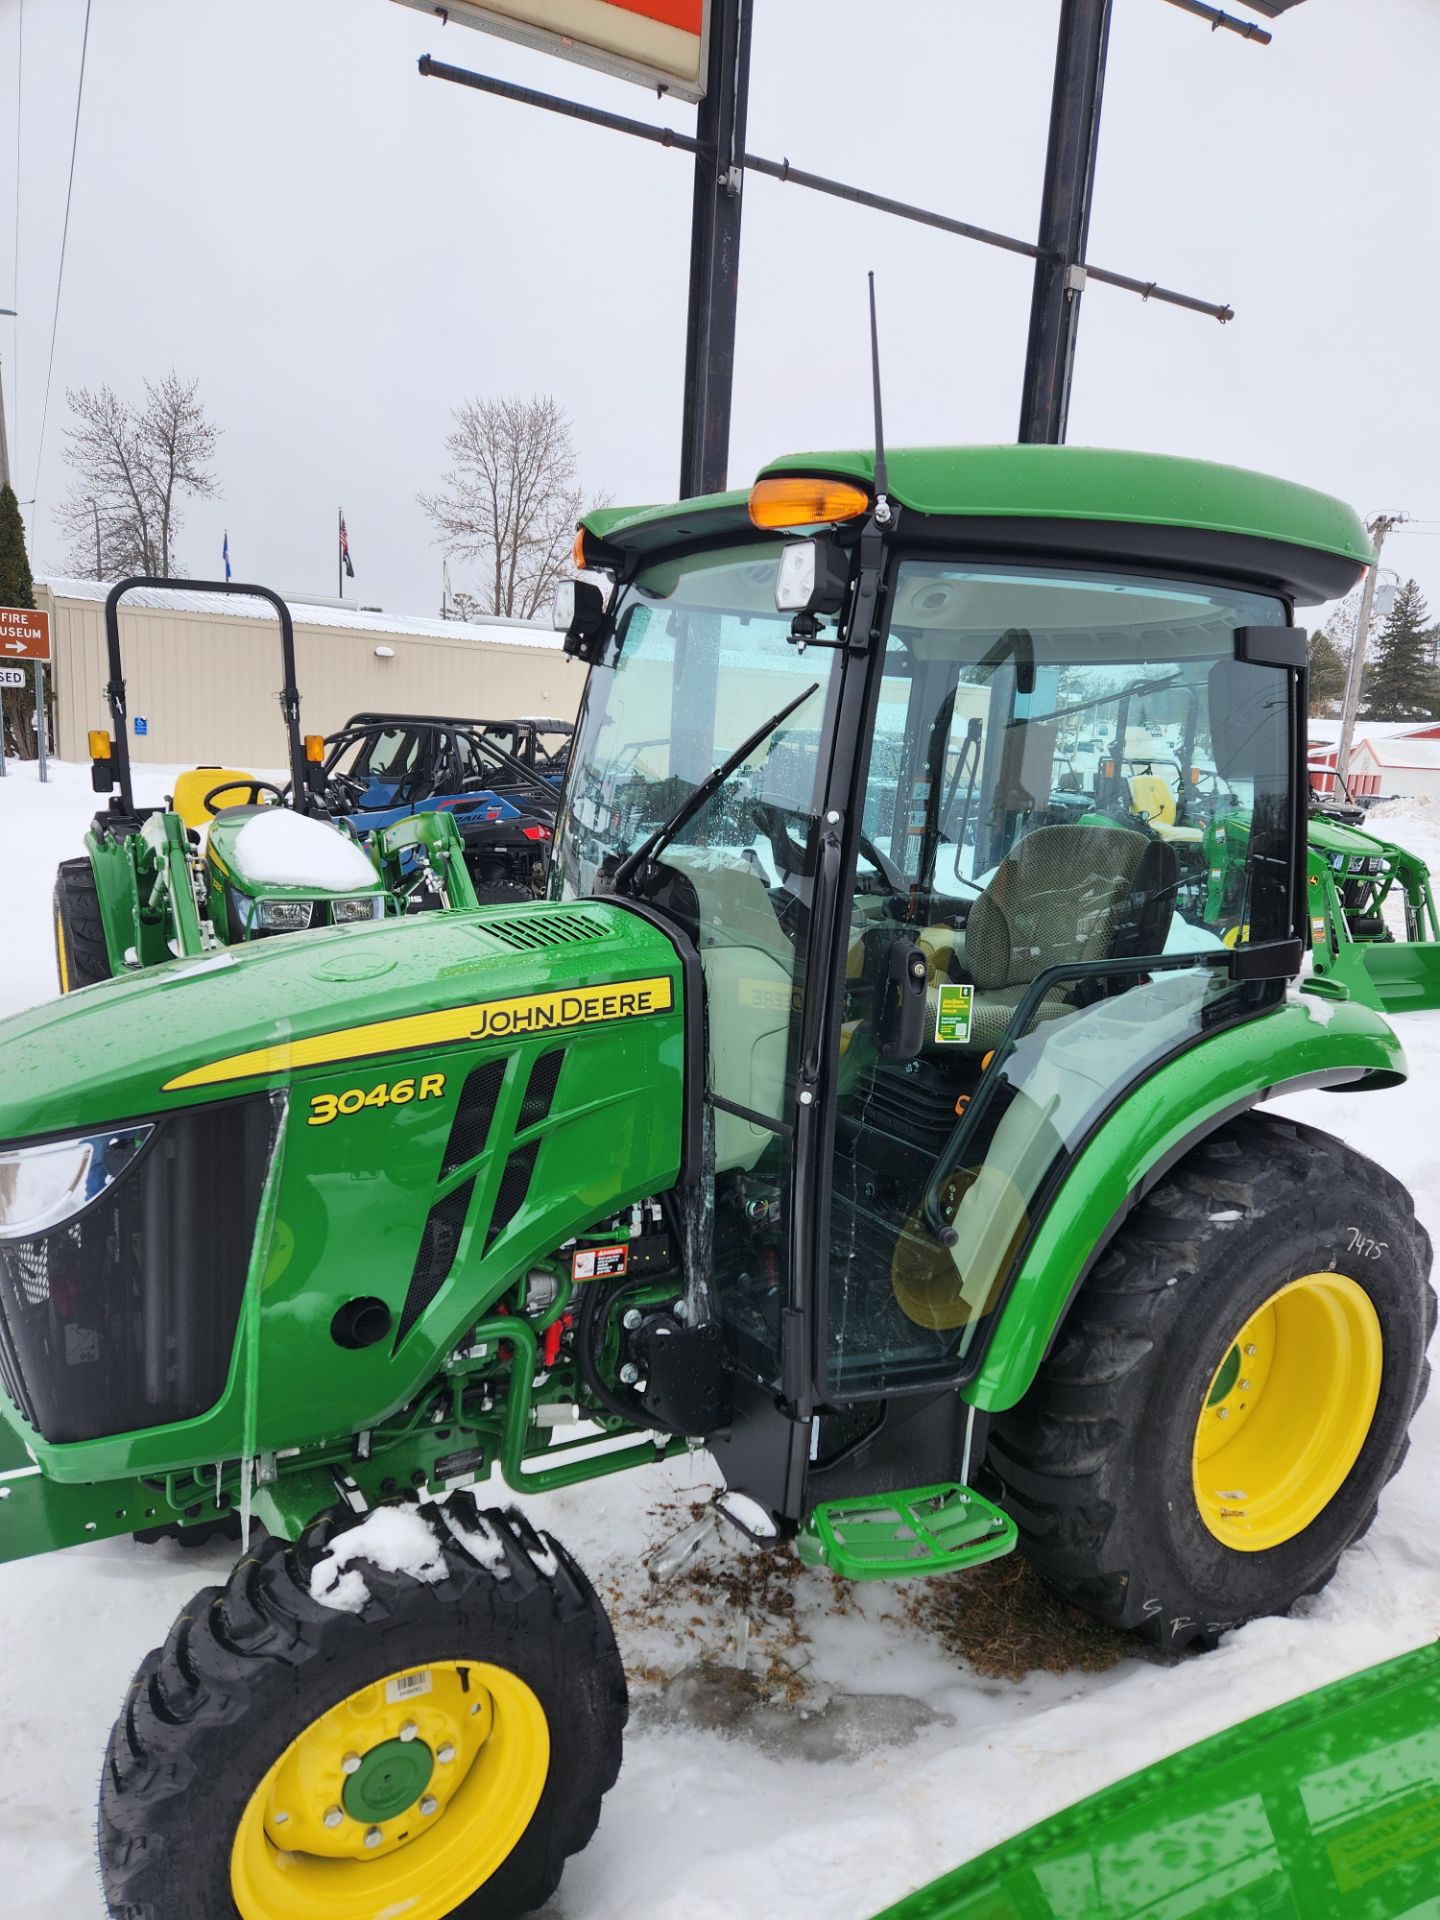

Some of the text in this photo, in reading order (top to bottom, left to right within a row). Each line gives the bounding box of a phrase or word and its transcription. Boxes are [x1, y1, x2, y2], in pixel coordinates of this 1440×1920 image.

[1, 613, 28, 624] FIRE
[0, 627, 41, 639] USEUM
[0, 673, 21, 683] SED
[470, 991, 653, 1036] JOHN DEERE
[307, 1073, 446, 1126] 3046R
[1346, 1227, 1389, 1259] 7475
